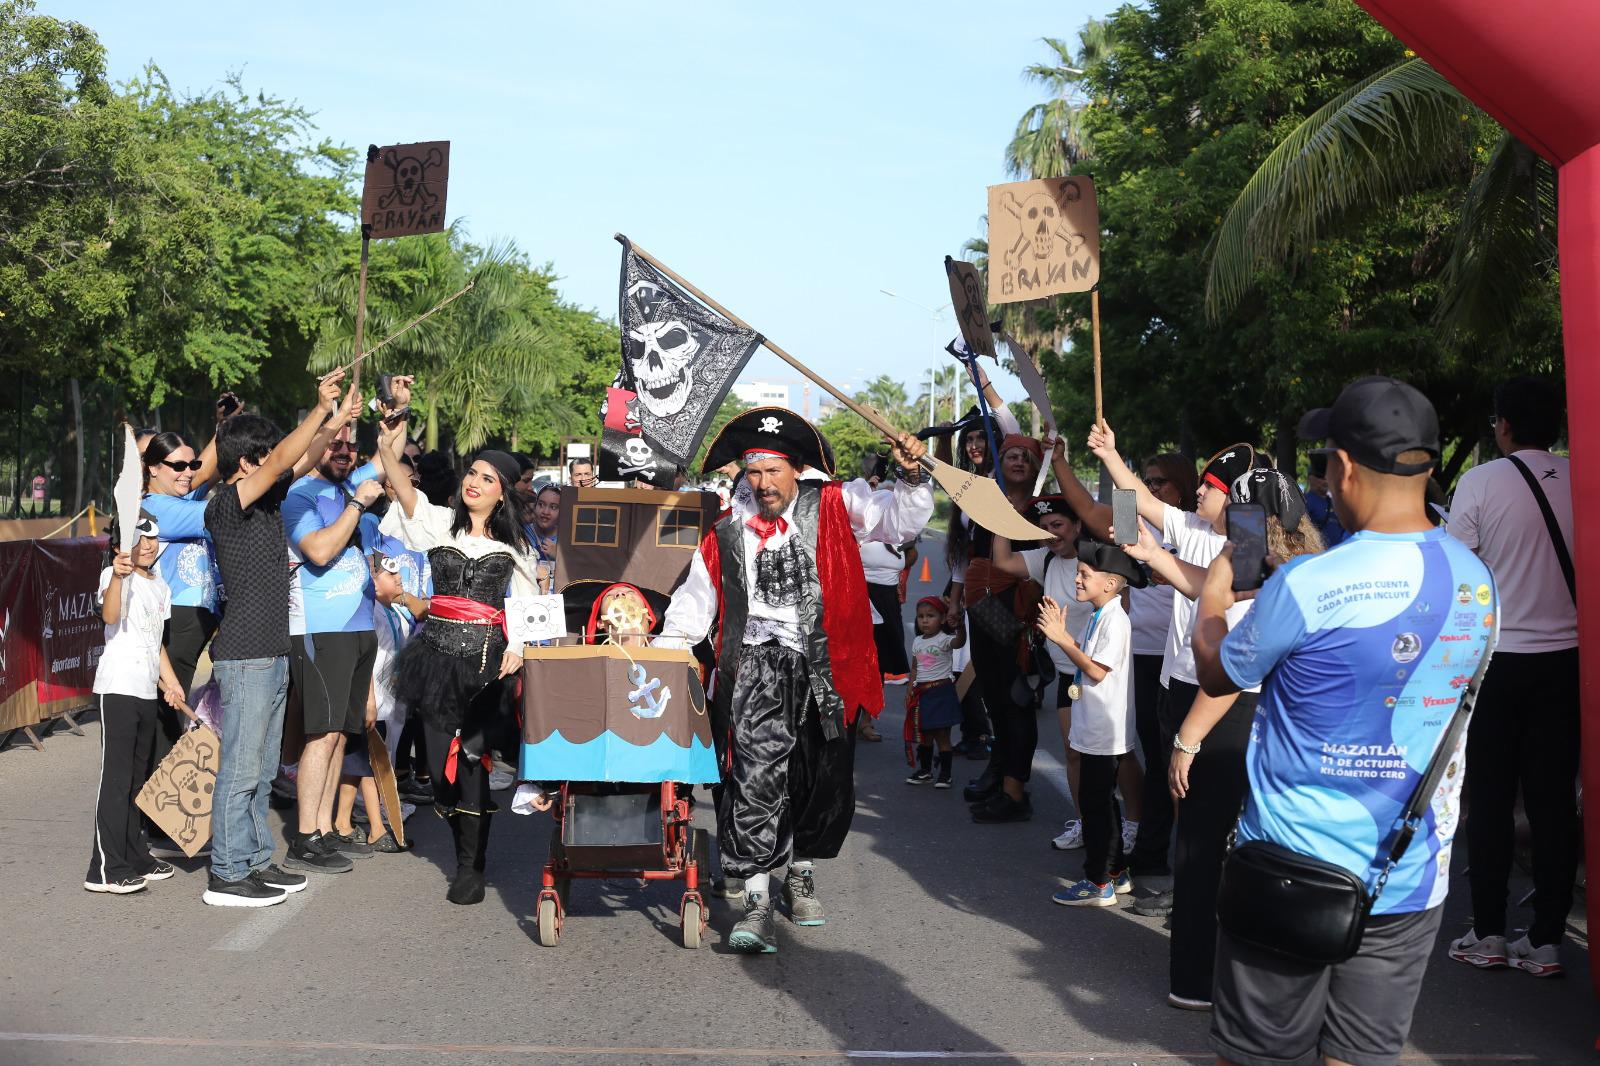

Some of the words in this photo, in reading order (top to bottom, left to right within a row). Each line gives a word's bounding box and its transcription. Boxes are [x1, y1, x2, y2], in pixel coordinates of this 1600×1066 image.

[1001, 255, 1092, 296] BRAYAN
[1317, 587, 1344, 603] CADA
[1345, 581, 1372, 593] PASO
[1374, 580, 1409, 590] CUENTA
[1316, 599, 1342, 614] CADA
[1343, 592, 1372, 605] META
[1373, 591, 1411, 600] INCLUYE
[1322, 742, 1409, 757] MAZATLÁN
[1320, 755, 1334, 766] 11
[1337, 758, 1352, 768] DE
[1354, 759, 1407, 769] OCTUBRE
[1320, 766, 1378, 779] KILÓMETRO
[1380, 770, 1407, 780] CERO
